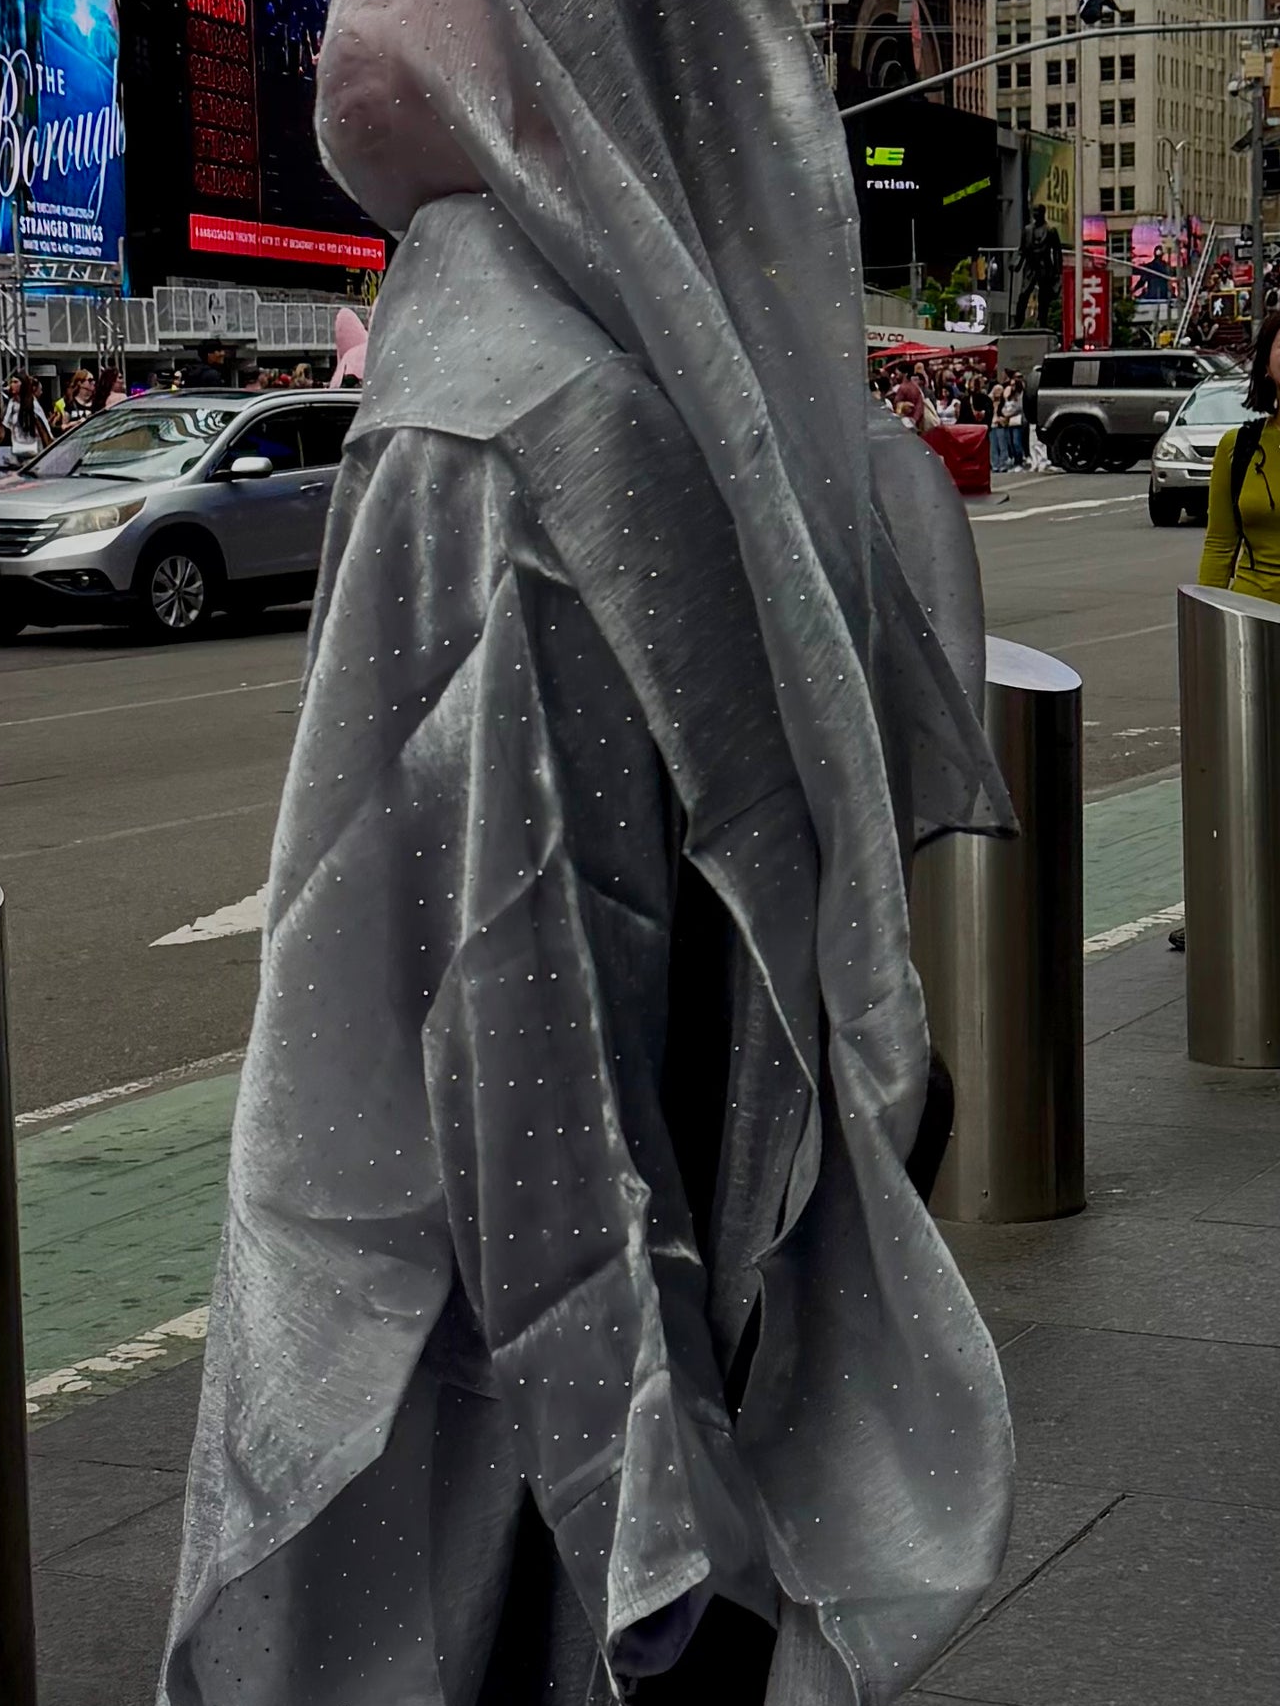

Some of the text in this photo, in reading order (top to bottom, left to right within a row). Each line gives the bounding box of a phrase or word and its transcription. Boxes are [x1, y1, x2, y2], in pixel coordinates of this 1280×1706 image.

[35, 63, 66, 96] THE
[19, 215, 104, 243] STRANGER THINGS
